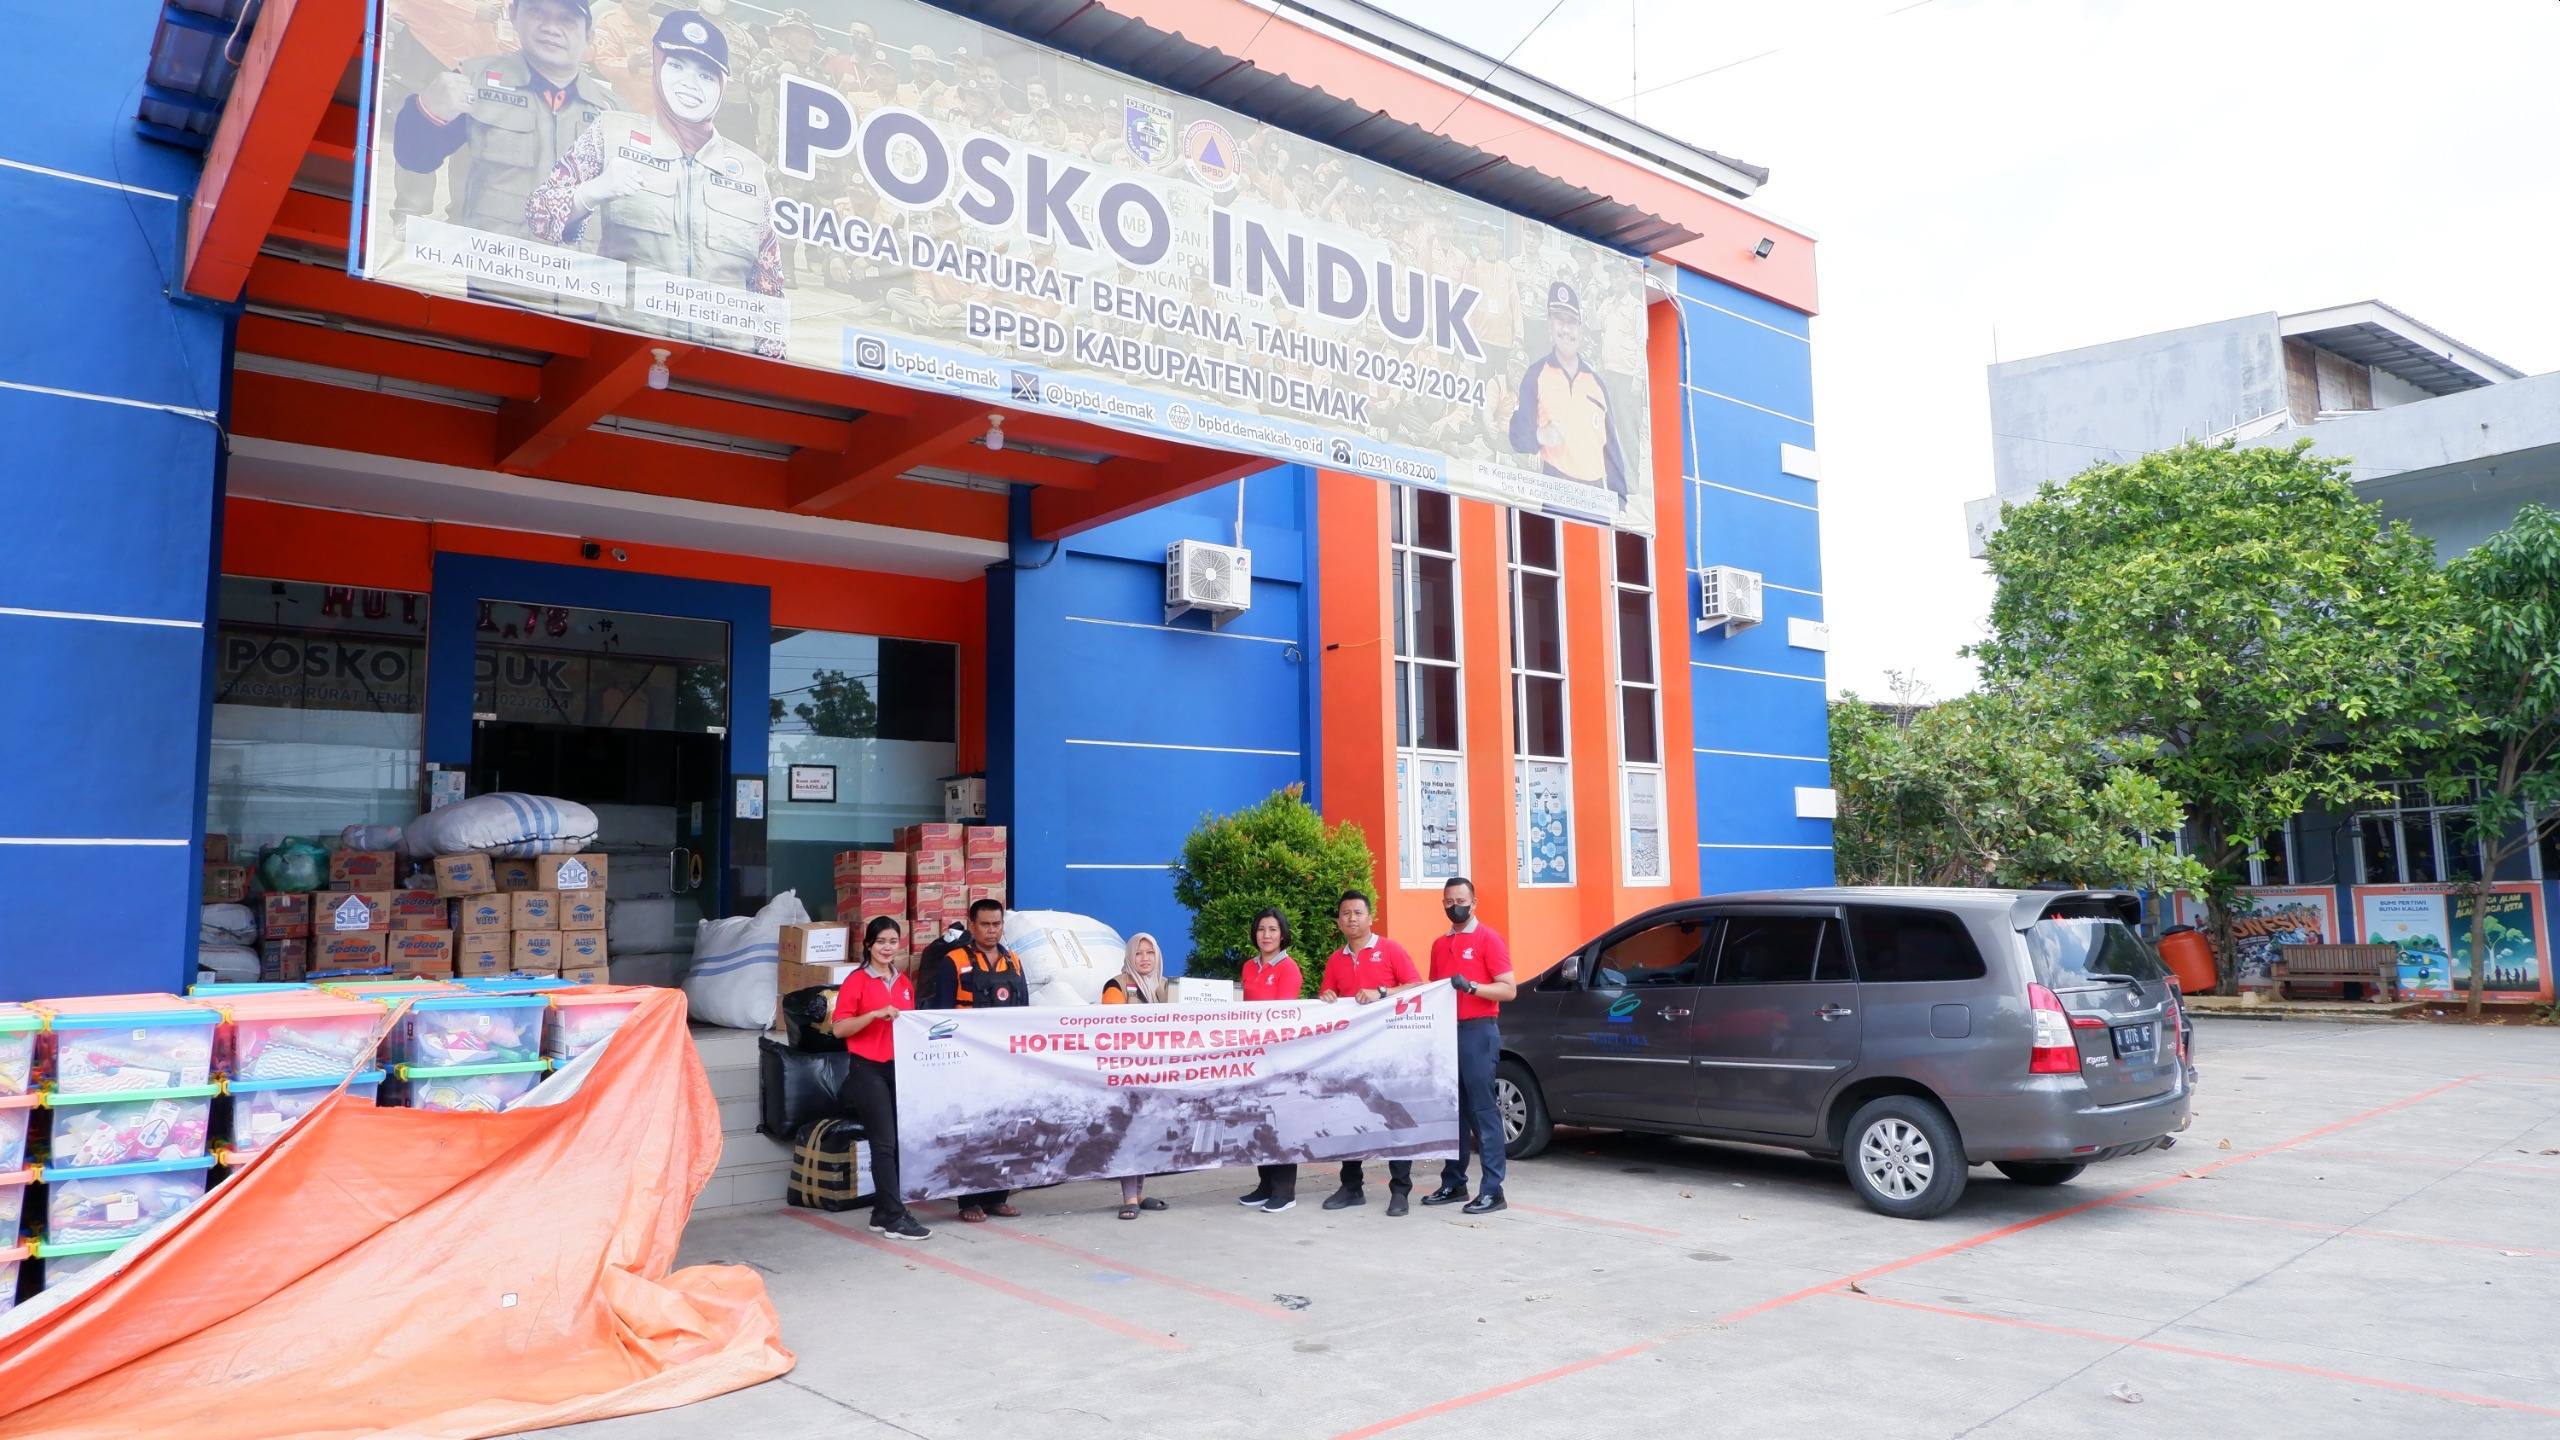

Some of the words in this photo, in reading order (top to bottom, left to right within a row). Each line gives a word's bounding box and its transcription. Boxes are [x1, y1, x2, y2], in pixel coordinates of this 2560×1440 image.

[621, 150, 668, 170] BUPATI
[1201, 164, 1224, 178] BPBD
[713, 177, 754, 193] BPBD
[785, 80, 1171, 266] POSKO
[1212, 210, 1483, 359] INDUK
[470, 236, 515, 259] Wakil
[518, 248, 571, 272] Bupati
[415, 246, 446, 263] KH.
[451, 254, 474, 270] Ali
[478, 259, 561, 290] Makhsun,
[565, 276, 585, 292] M.
[664, 281, 713, 304] Bupati
[715, 288, 767, 314] Demak
[773, 200, 900, 263] SIAGA
[912, 235, 1083, 303] DARURAT
[1093, 281, 1243, 345] BENCANA
[1252, 321, 1348, 373] TAHUN
[1356, 350, 1485, 407] 2023/2024
[763, 320, 782, 335] SE
[969, 304, 1065, 352] BPBD
[1076, 328, 1261, 400] KABUPATEN
[1270, 375, 1369, 425] DEMAK
[894, 352, 998, 388] bpbd_demak
[1046, 385, 1155, 421] @bpbd_demak
[1197, 413, 1324, 454] bpbd.demakkab.go.id
[1357, 452, 1392, 474] (0291)
[1395, 461, 1437, 481] 682200
[228, 638, 407, 682] POSKO
[475, 653, 569, 691] DUK
[448, 863, 473, 875] AQUA
[525, 900, 549, 908] AQUA
[475, 915, 500, 925] AQUA
[572, 913, 595, 922] AQUA
[327, 943, 376, 954] Sedaap
[398, 938, 445, 949] Sedaap
[527, 938, 551, 948] AQUA
[574, 938, 597, 947] AQUA
[1059, 1014, 1127, 1028] Corporate
[1130, 1013, 1170, 1024] Social
[1172, 1008, 1262, 1024] Responsibility
[1266, 1007, 1303, 1021] (CSR)
[1010, 1033, 1090, 1054] HOTEL
[1094, 1030, 1205, 1051] CIPUTRA
[1209, 1019, 1351, 1048] SEMARANG
[1096, 1055, 1164, 1071] PEDULI
[1107, 1069, 1180, 1086] BANJIR
[1185, 1062, 1257, 1080] DEMAK
